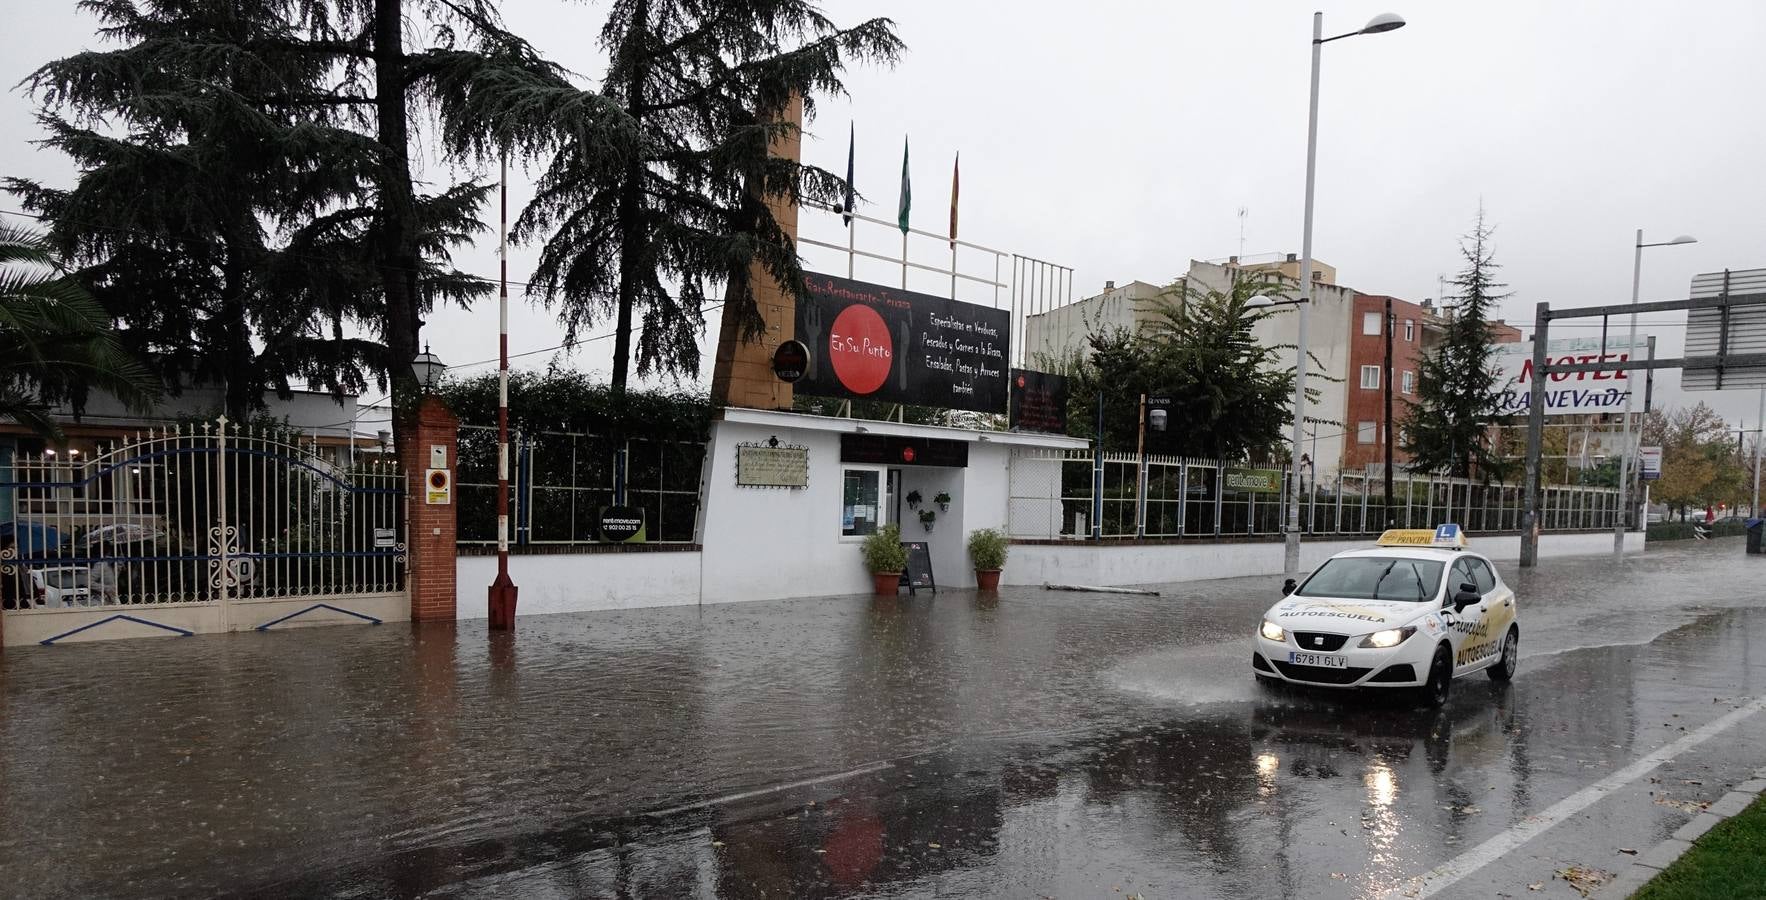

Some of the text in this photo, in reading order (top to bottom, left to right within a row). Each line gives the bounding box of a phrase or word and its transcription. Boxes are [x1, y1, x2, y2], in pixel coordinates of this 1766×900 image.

[930, 312, 964, 330] Especialistas
[966, 323, 972, 331] en
[832, 334, 891, 358] En Su Punto
[922, 332, 948, 348] Pescados
[949, 343, 953, 354] y
[955, 339, 974, 352] Carnes
[981, 342, 985, 355] la
[956, 358, 973, 374] Pastas
[974, 367, 978, 379] y
[980, 361, 1000, 377] Arroces
[953, 381, 973, 395] también
[1397, 536, 1432, 545] PRINCIPAL
[1440, 526, 1450, 537] L
[1280, 611, 1385, 623] AUTOESCUELA
[1440, 610, 1490, 640] Principal
[1295, 654, 1345, 667] 6781 GLV
[1456, 639, 1502, 668] AUTOESCUELA
